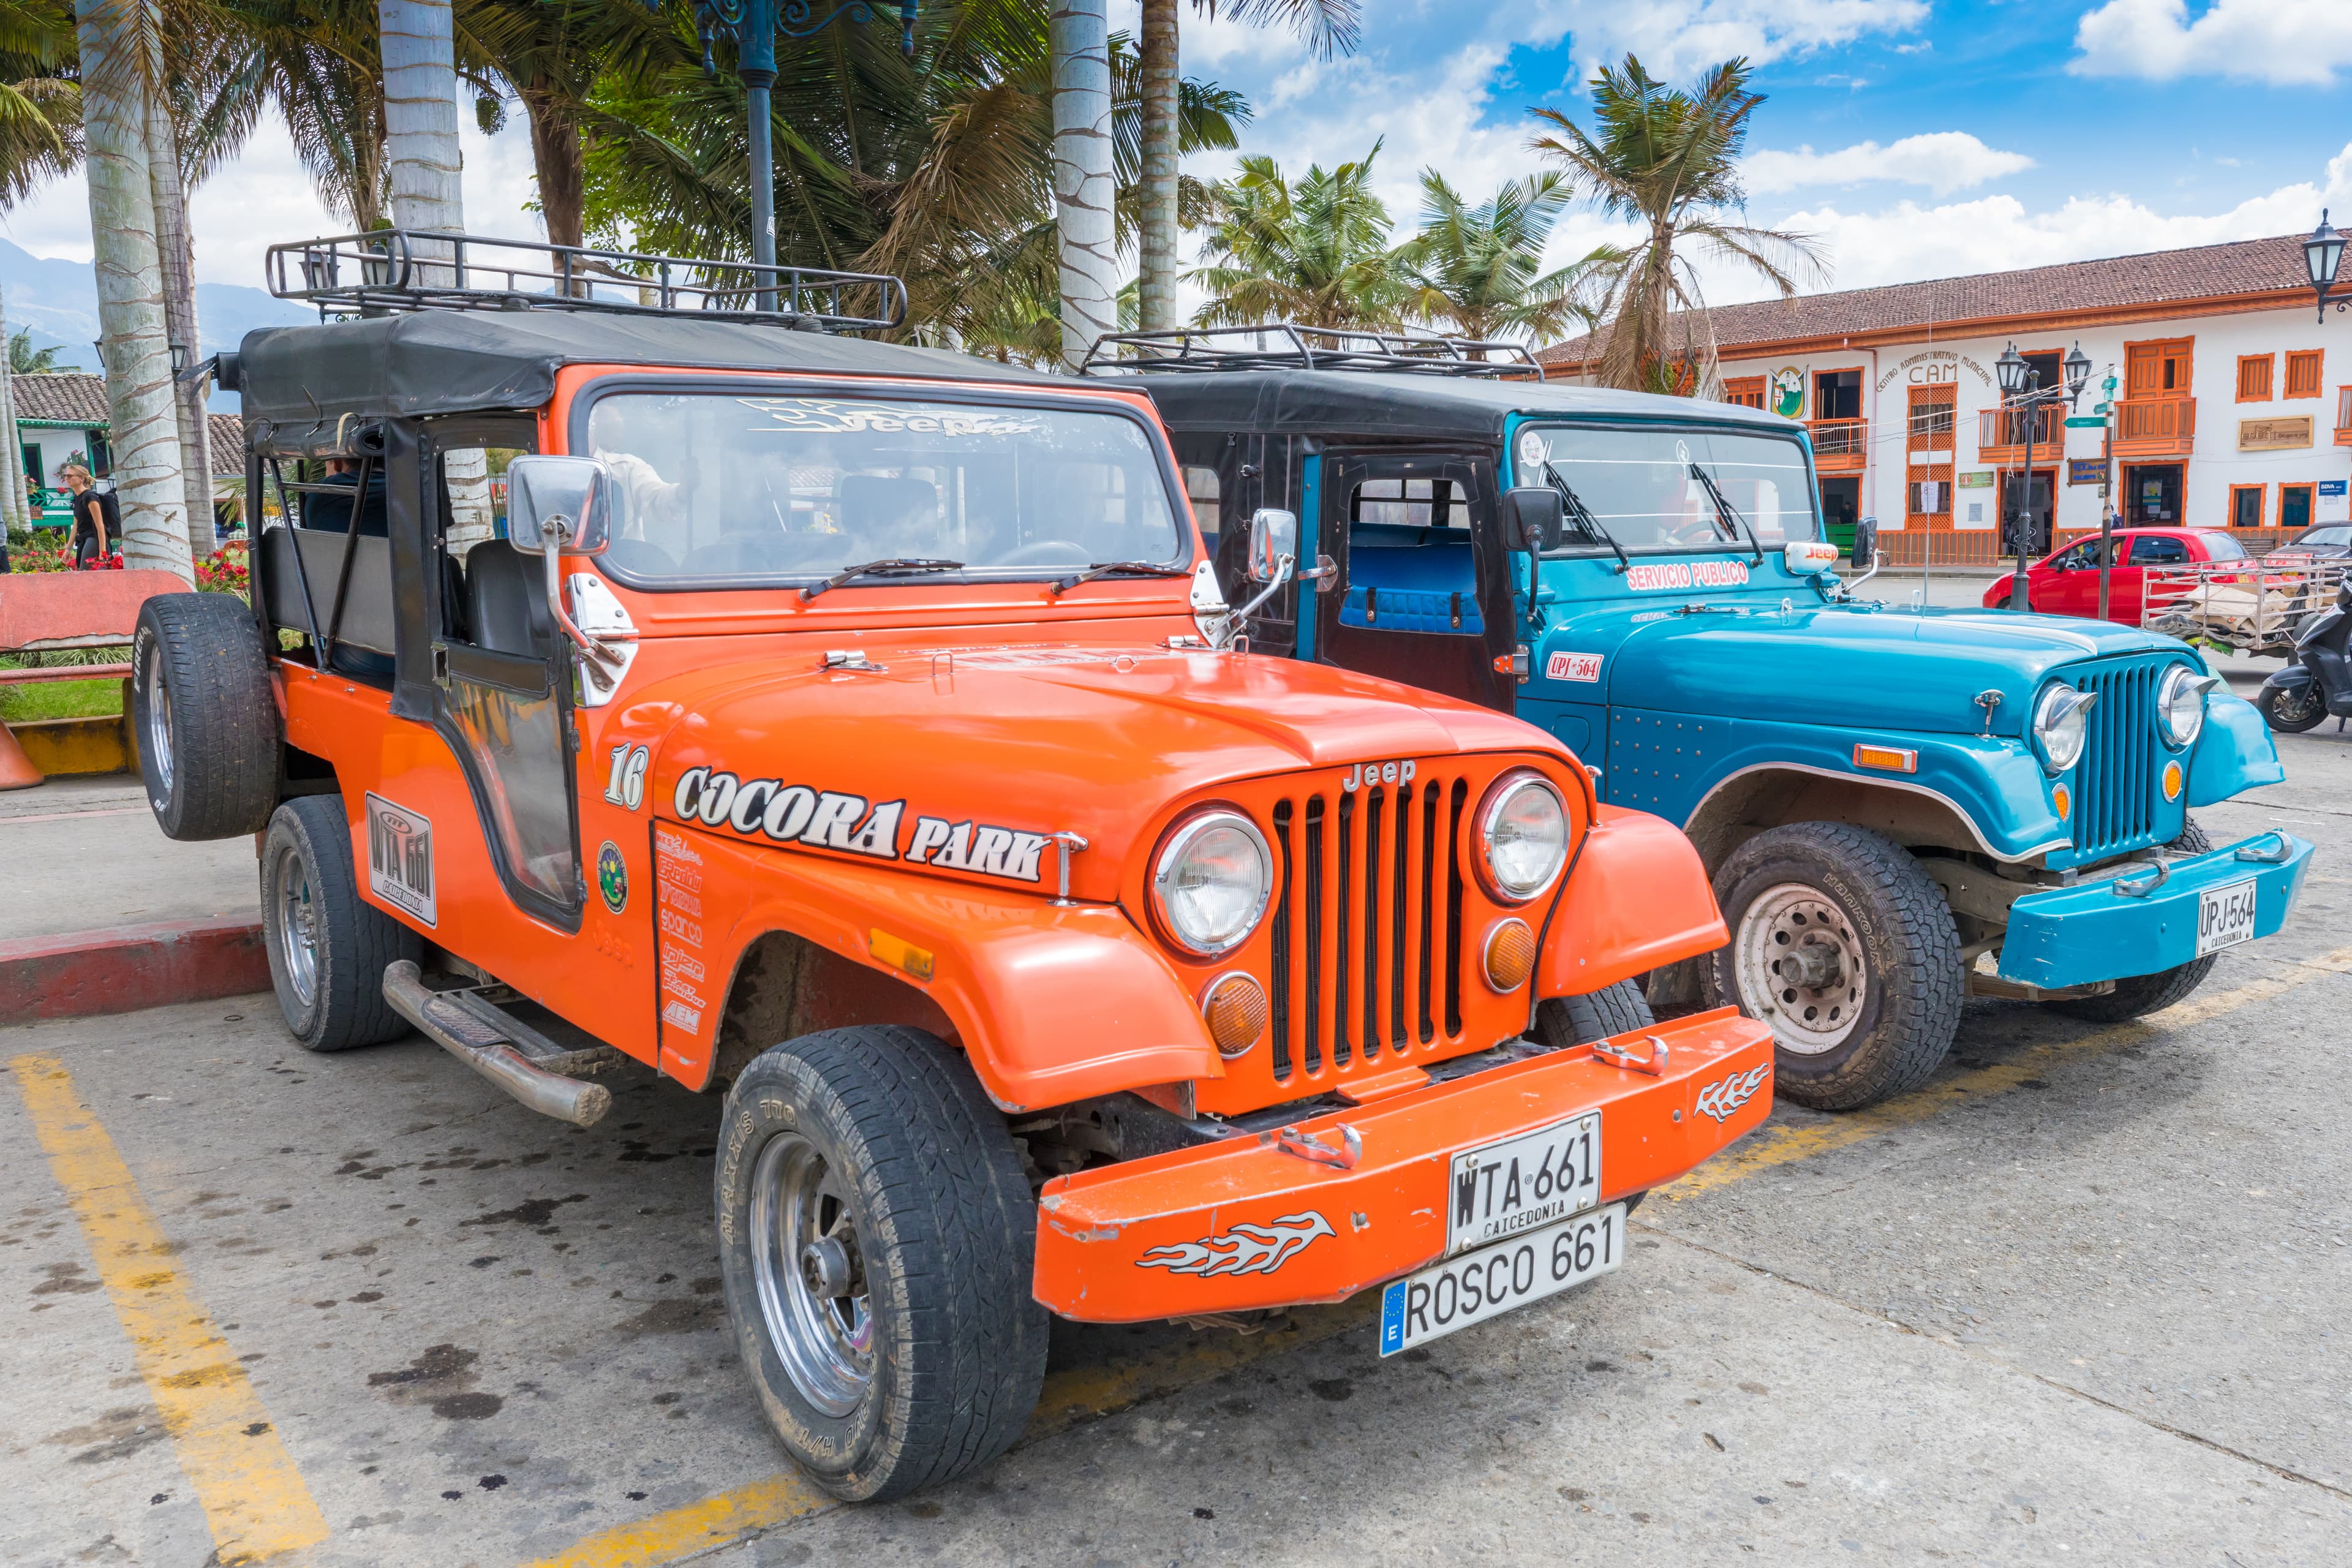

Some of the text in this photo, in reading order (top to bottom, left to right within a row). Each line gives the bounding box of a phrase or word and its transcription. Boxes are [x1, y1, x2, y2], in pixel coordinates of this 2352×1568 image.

[1876, 350, 1993, 393] CENTRO ADMINISTRATIVO MUNICIPAL
[1909, 363, 1958, 383] CAM
[840, 413, 975, 437] Jeep
[1805, 546, 1838, 562] Jeep
[1627, 560, 1748, 590] SERVICIO PUBLICO
[1551, 657, 1597, 677] UPJ 564
[605, 741, 649, 812] 16
[1343, 760, 1416, 793] Jeep
[675, 766, 905, 859] COCORA
[906, 818, 1051, 881] PARK
[369, 804, 431, 900] WTA 661
[657, 834, 673, 848] HKS
[383, 880, 423, 913] CAICEDONIA
[662, 909, 703, 943] sparco
[2201, 891, 2254, 938] UPJ 564
[2212, 930, 2242, 948] CAICEDONIA
[665, 1003, 699, 1028] AEM
[721, 1111, 755, 1246] MAXXIS
[1457, 1132, 1594, 1229] WTA 661
[1483, 1199, 1565, 1238] CAICEDONIA
[1405, 1215, 1612, 1340] ROSCO 661
[1388, 1324, 1398, 1341] E
